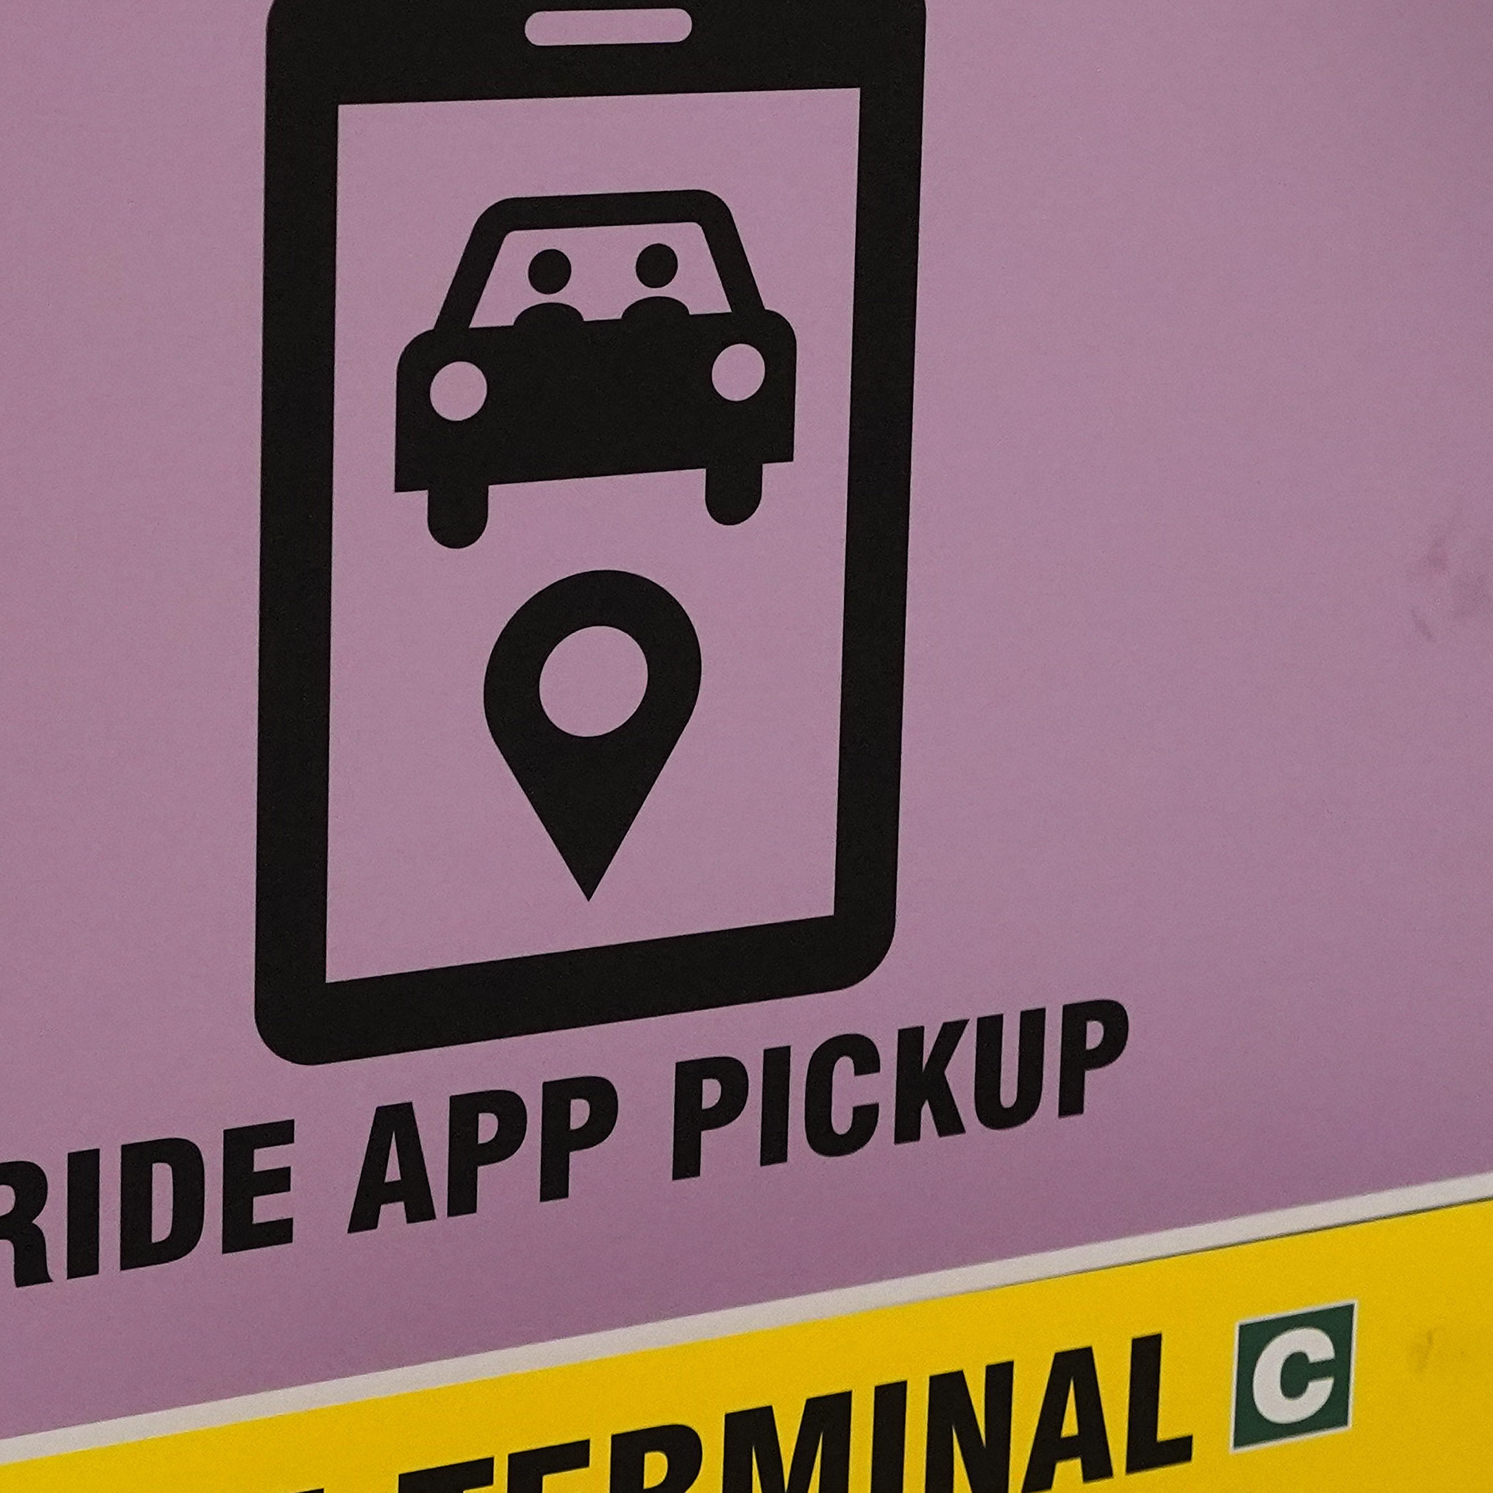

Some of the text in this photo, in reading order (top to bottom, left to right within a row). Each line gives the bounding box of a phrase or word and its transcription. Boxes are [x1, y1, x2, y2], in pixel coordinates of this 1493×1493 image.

[347, 1076, 618, 1233] APP
[672, 999, 1129, 1181] PICKUP
[398, 1328, 1335, 1493] MINAL C
